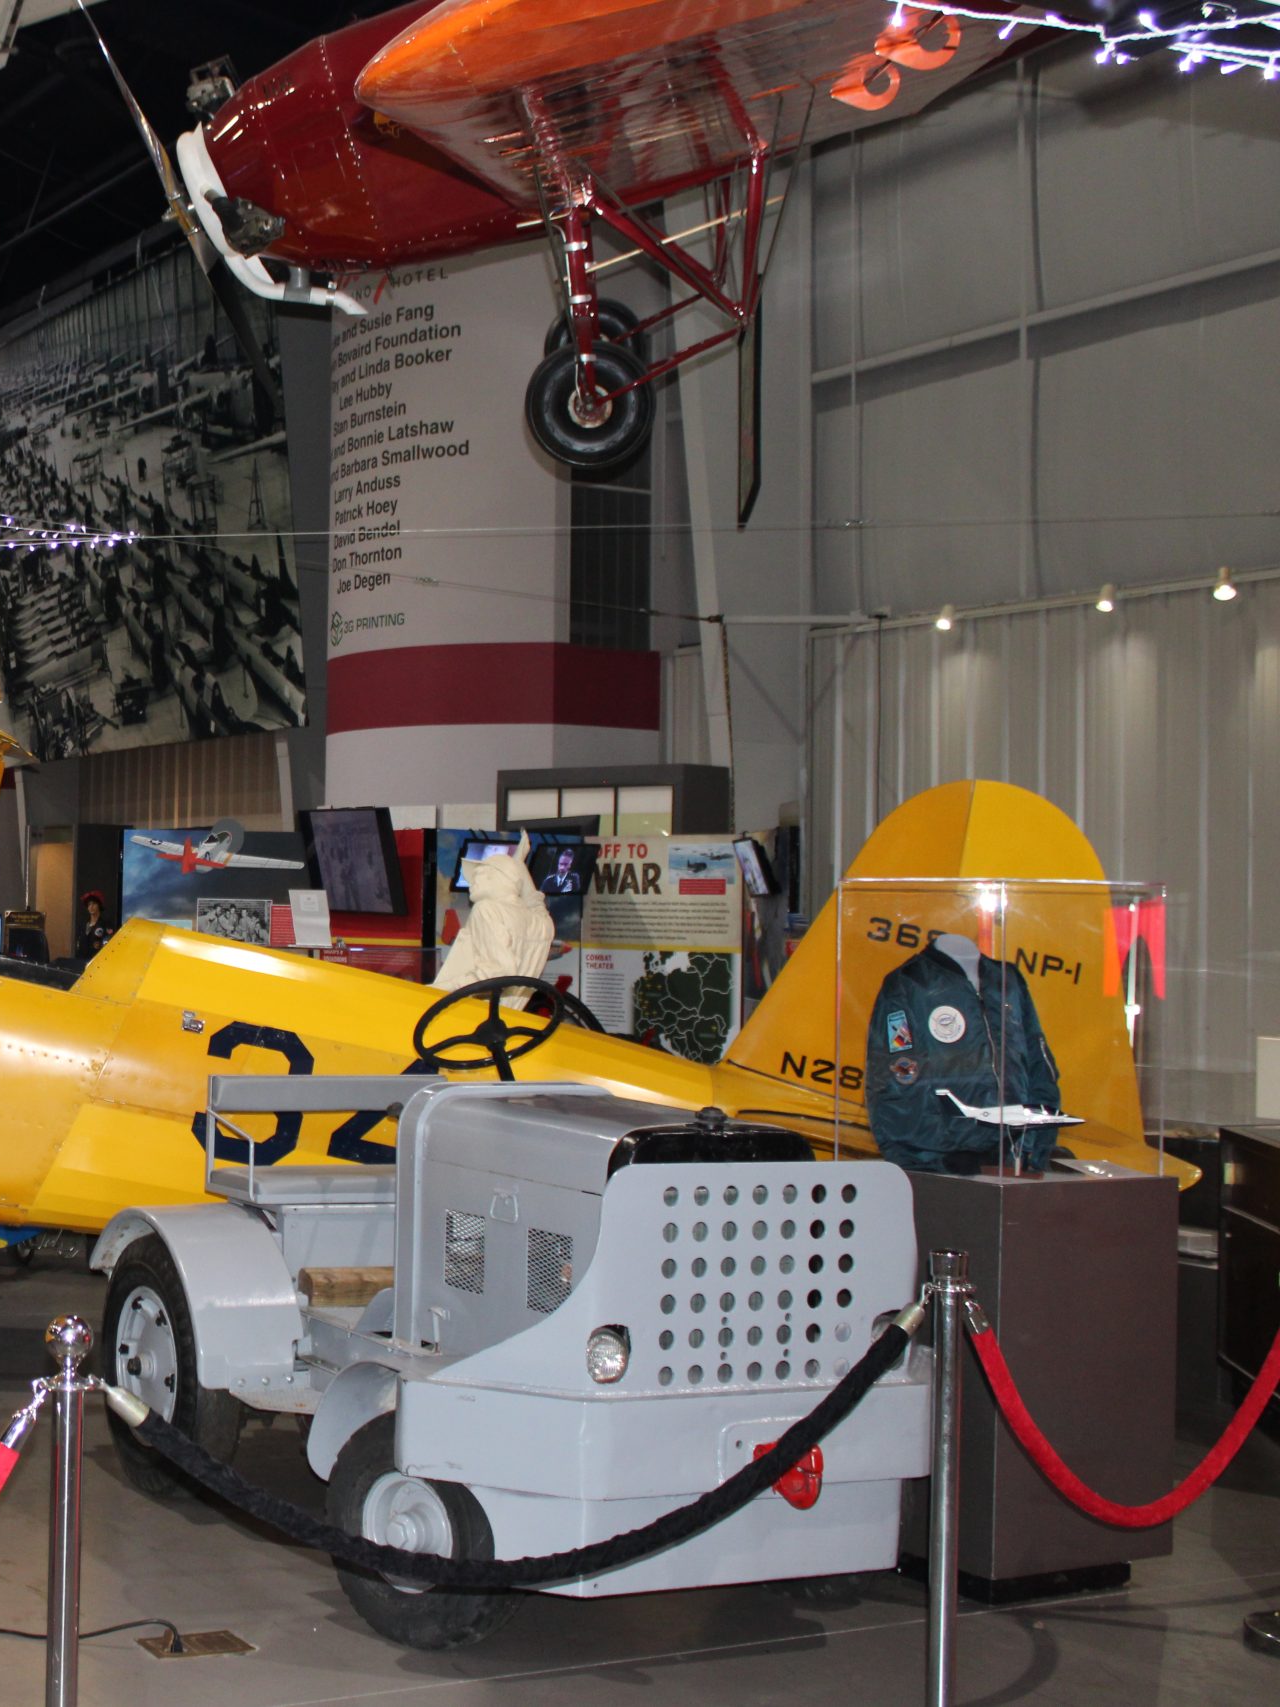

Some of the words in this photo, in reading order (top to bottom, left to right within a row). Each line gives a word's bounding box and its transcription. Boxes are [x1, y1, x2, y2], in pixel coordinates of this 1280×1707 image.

[391, 267, 448, 289] HOTEL
[342, 323, 357, 343] and
[360, 312, 392, 335] Susie
[396, 304, 434, 323] Fang
[338, 340, 371, 368] Bovaird
[375, 324, 461, 352] Foundation
[341, 368, 356, 388] and
[359, 358, 390, 380] Linda
[395, 349, 452, 369] Booker
[339, 395, 353, 412] Lee
[356, 382, 392, 402] Hubby
[333, 419, 348, 437] Stan
[350, 401, 406, 429] Burnstein
[348, 429, 384, 453] Bonnie
[388, 420, 454, 441] Latshaw
[341, 456, 377, 478] Barbara
[382, 440, 469, 467] Smallwood
[334, 486, 353, 504] Larry
[356, 475, 400, 497] Anduss
[335, 504, 363, 526] Patrick
[366, 499, 398, 516] Hoey
[334, 528, 356, 550] David
[358, 520, 400, 542] Bendel
[333, 558, 347, 573] Don
[349, 546, 402, 567] Thornton
[337, 578, 351, 594] Joe
[354, 573, 391, 591] Degen
[356, 612, 405, 631] PRINTING
[627, 843, 648, 859] TO
[593, 863, 661, 895] WAR
[586, 962, 614, 970] THEATER
